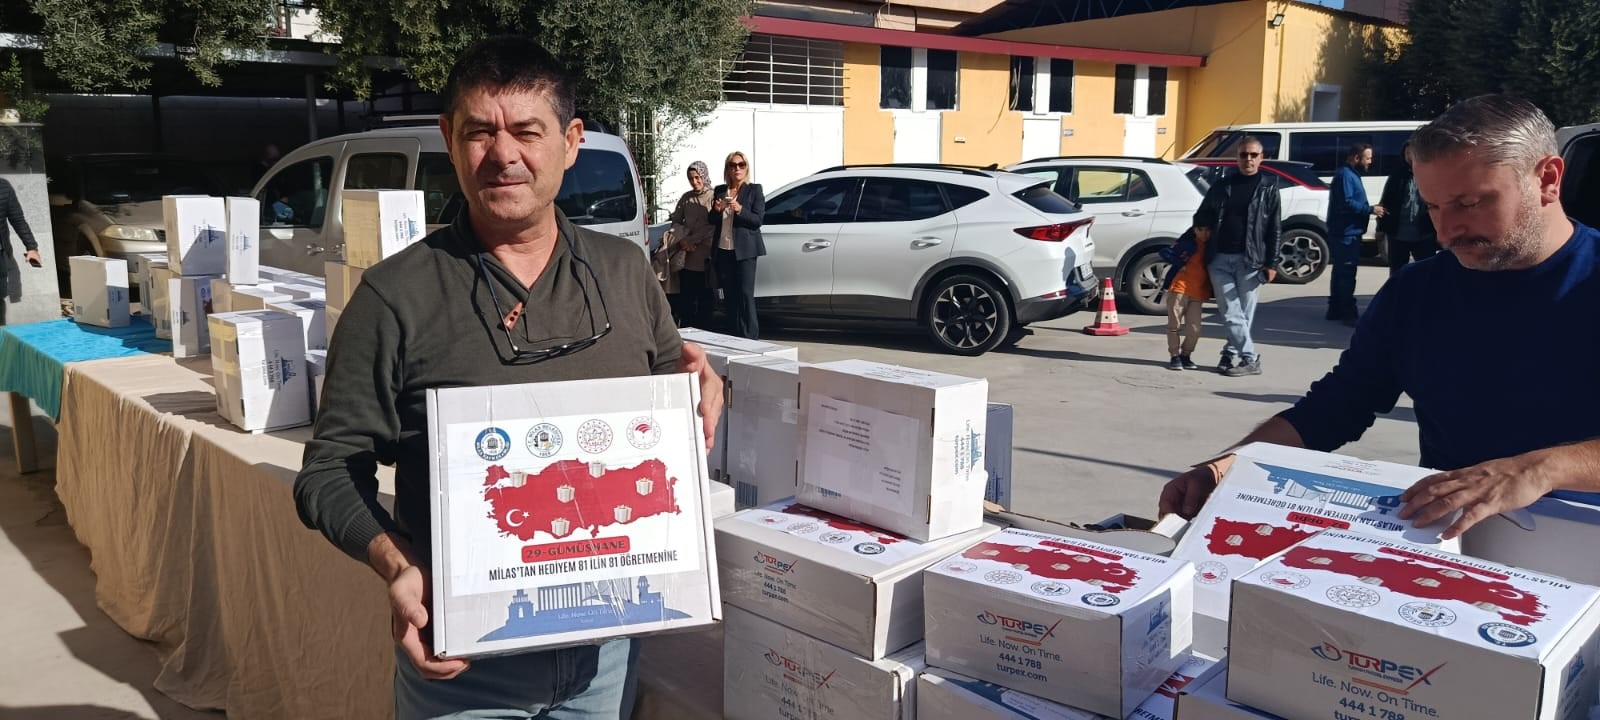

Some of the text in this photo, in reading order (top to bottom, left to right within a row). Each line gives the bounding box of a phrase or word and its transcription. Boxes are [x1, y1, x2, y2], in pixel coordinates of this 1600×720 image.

[489, 549, 678, 582] MİLAS'TAN HEDİYEM 81 İLİN 81 ÖĞRETMENİNE
[996, 615, 1063, 641] TURPEX
[998, 652, 1042, 670] 444 1 788
[1022, 645, 1036, 656] On
[996, 663, 1048, 682] turpex.com
[1342, 649, 1448, 690] TURPEX
[1312, 671, 1337, 689] Life.
[1340, 680, 1374, 699] Now.
[1377, 691, 1398, 706] On
[1401, 697, 1440, 718] Time.
[1339, 697, 1405, 720] 444 1 788
